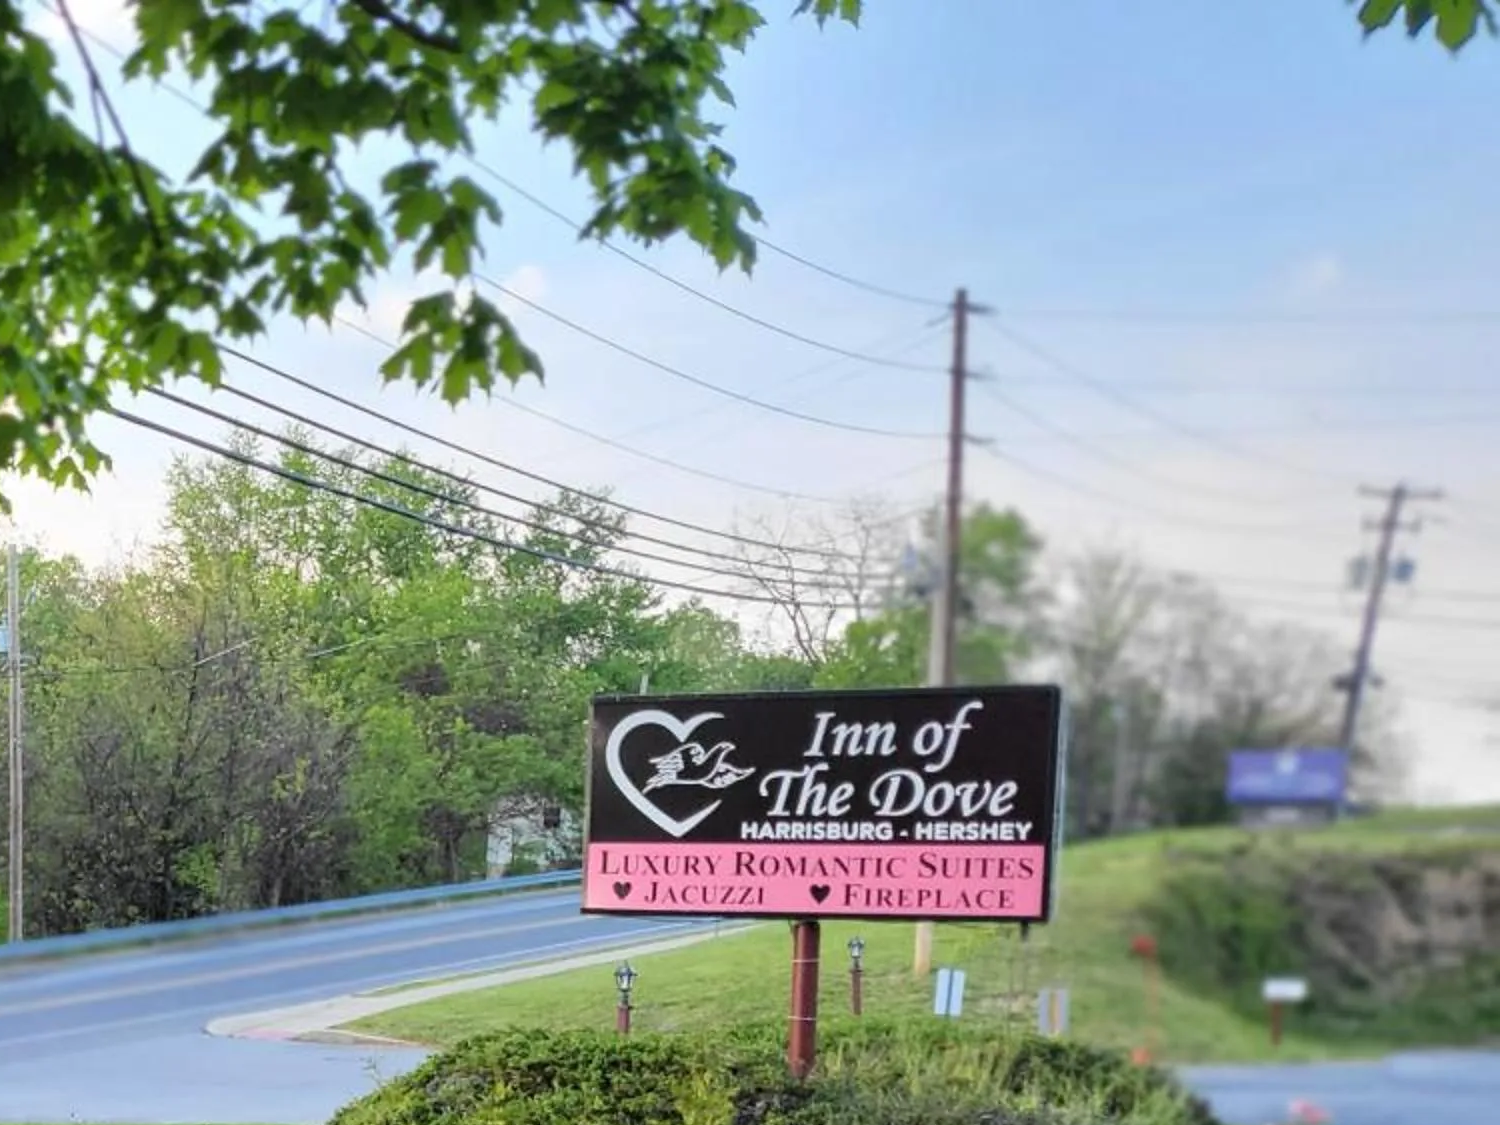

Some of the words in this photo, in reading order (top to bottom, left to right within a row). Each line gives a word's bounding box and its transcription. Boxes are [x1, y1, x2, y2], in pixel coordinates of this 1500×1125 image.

[803, 711, 897, 757] Inn
[912, 700, 984, 772] of
[759, 762, 852, 817] The
[869, 768, 1019, 817] Dove
[740, 821, 894, 841] HARRISBURG
[915, 821, 1033, 841] HERSHEY
[599, 850, 722, 877] LUXURY
[734, 850, 907, 878] ROMANTIC
[917, 852, 1035, 879] SUITES
[643, 881, 764, 906] JACUZZI
[843, 883, 1015, 909] FIREPLACE
